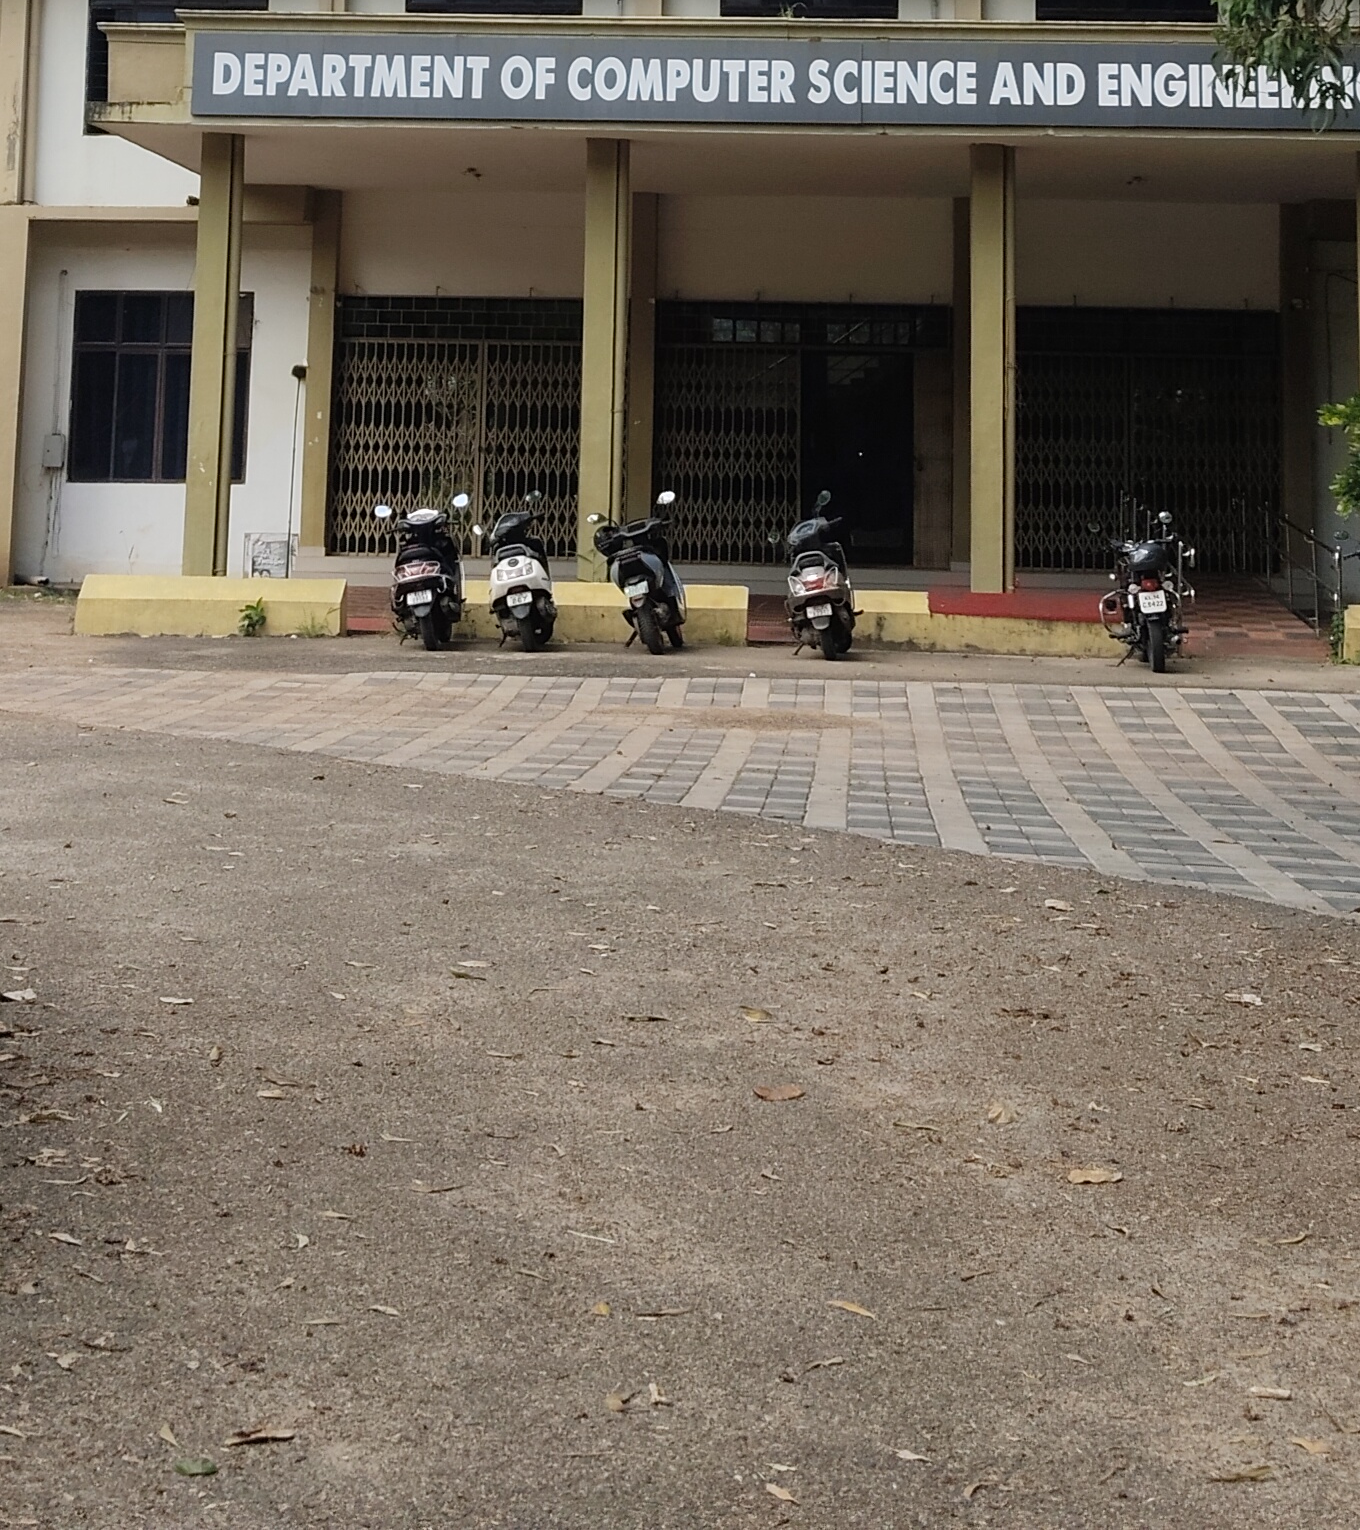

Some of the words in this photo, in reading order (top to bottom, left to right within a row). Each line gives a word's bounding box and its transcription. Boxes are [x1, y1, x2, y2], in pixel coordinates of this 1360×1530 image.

[212, 51, 490, 99] DEPARTMENT
[500, 55, 556, 100] OF
[567, 56, 796, 104] COMPUTER
[807, 59, 977, 105] SCIENCE
[989, 61, 1086, 106] AND
